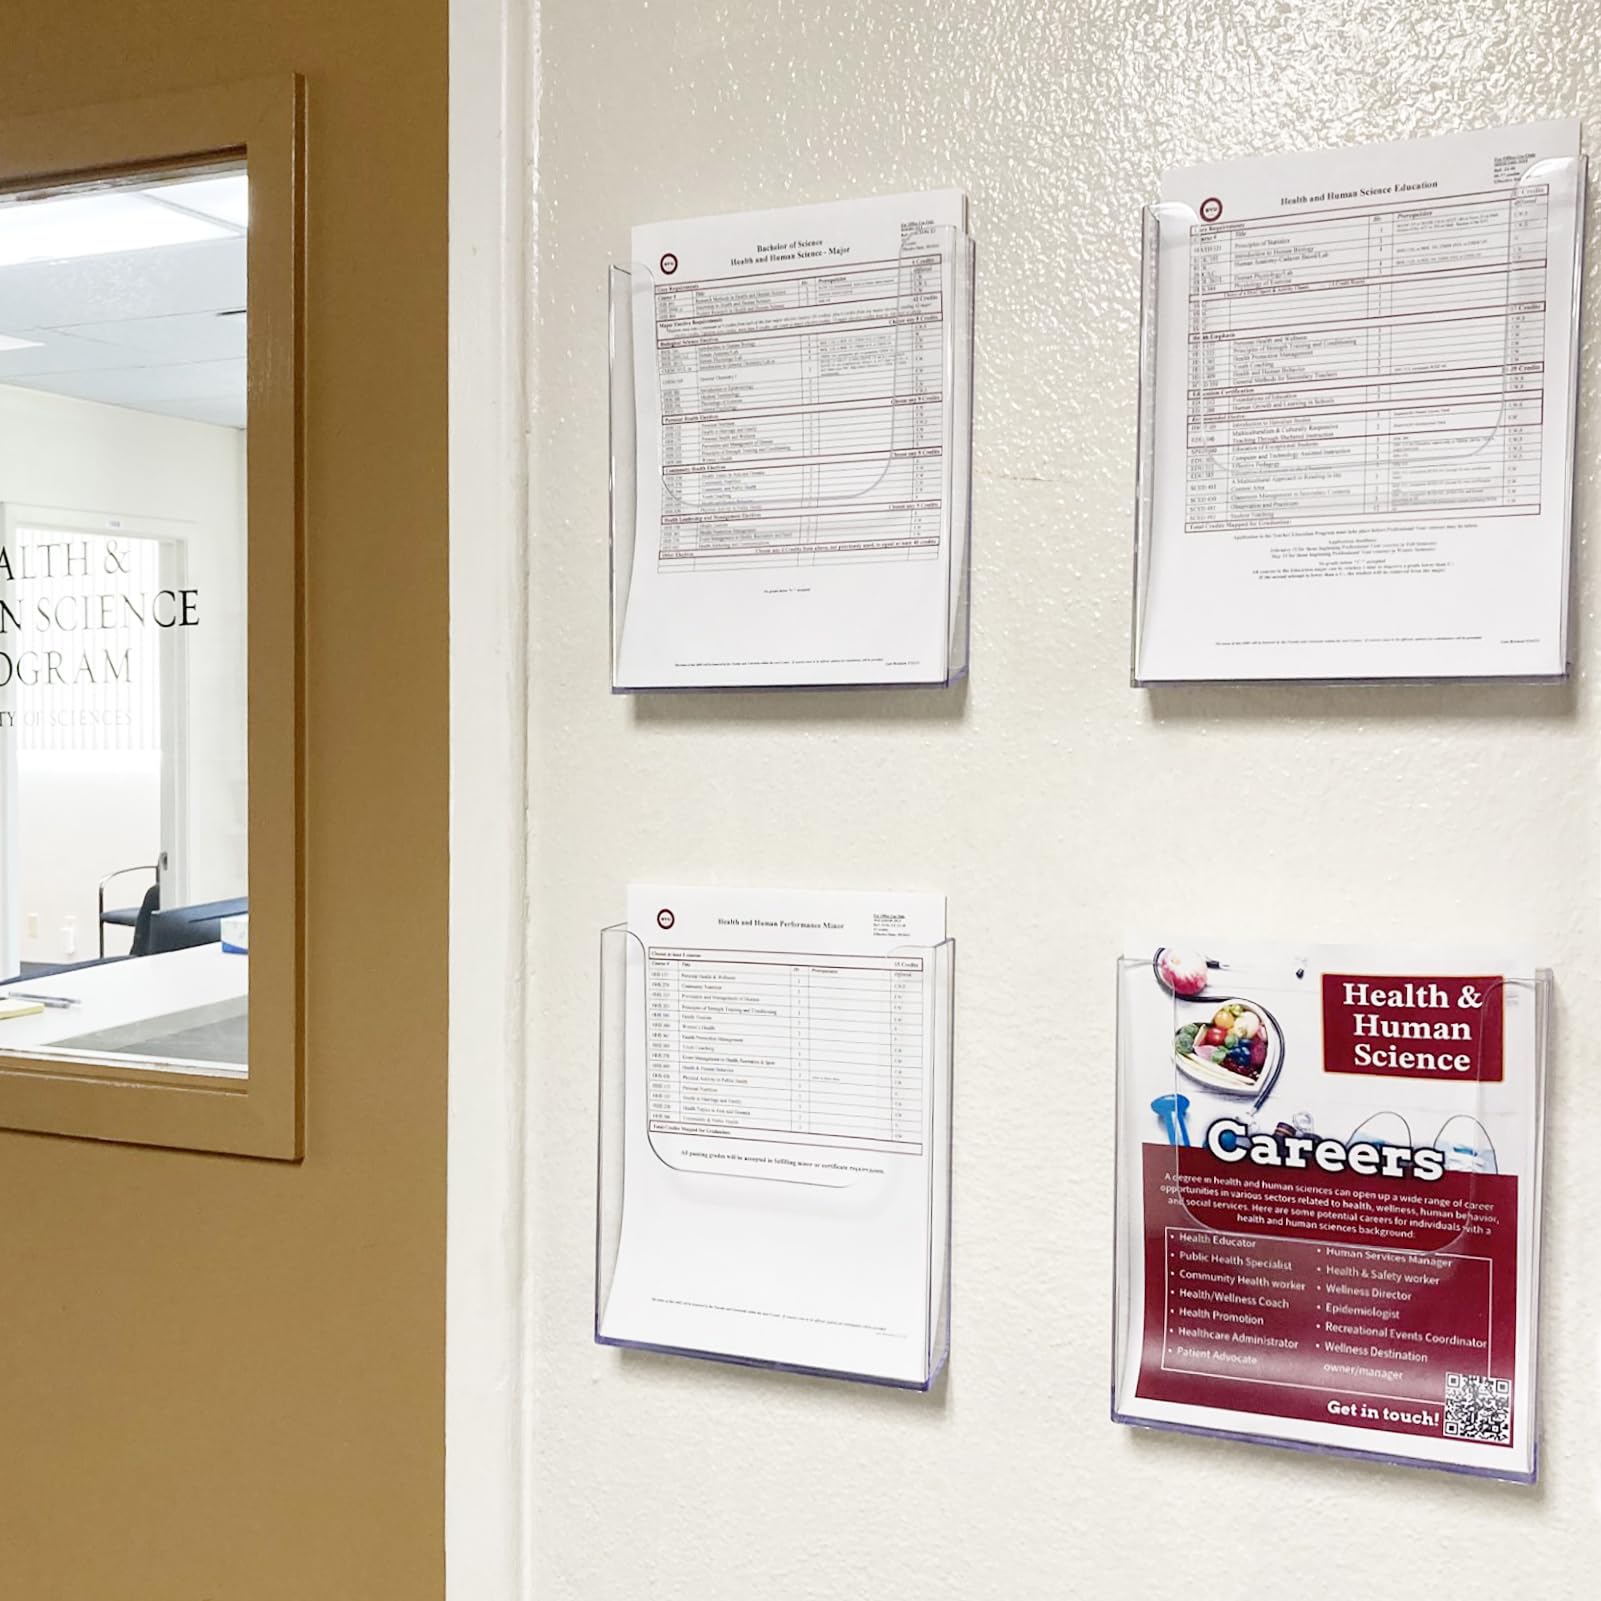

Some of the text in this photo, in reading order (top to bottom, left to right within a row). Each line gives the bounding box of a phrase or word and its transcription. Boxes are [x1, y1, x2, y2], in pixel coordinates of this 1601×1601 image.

[1281, 181, 1438, 206] Health and Human Science Education
[731, 256, 753, 266] Health
[755, 255, 768, 263] and
[770, 254, 795, 262] Human
[797, 250, 822, 258] Science
[828, 247, 850, 256] Major
[757, 244, 787, 253] Bachelor
[798, 239, 823, 248] Science
[104, 539, 131, 575] &
[36, 589, 200, 632] SCIENCE
[50, 711, 133, 727] SCIENCES
[718, 918, 739, 926] Health
[779, 920, 821, 929] Performance
[1342, 983, 1482, 1009] Health &
[1353, 1013, 1472, 1041] Human
[1354, 1044, 1471, 1072] Science
[1208, 1118, 1445, 1182] Careers
[822, 1162, 848, 1170] certificate
[1172, 1174, 1202, 1184] degree
[1214, 1176, 1242, 1187] health
[1243, 1179, 1260, 1188] and
[1261, 1180, 1294, 1192] human
[1295, 1184, 1333, 1196] sciences
[1335, 1188, 1351, 1197] can
[1352, 1190, 1376, 1200] open
[1378, 1193, 1390, 1201] up
[1400, 1194, 1423, 1204] wide
[1424, 1198, 1451, 1208] range
[1452, 1199, 1463, 1208] of
[1464, 1201, 1494, 1211] career
[1160, 1184, 1500, 1225] opportunities in various sectors related to health, wellness, human behavior,
[1168, 1197, 1185, 1205] and
[1186, 1198, 1211, 1207] social
[1213, 1201, 1248, 1211] services.
[1252, 1204, 1272, 1213] Here
[1274, 1207, 1289, 1215] are
[1291, 1208, 1315, 1217] some
[1317, 1209, 1358, 1221] potential
[1359, 1215, 1393, 1225] careers
[1394, 1217, 1407, 1226] for
[1409, 1219, 1461, 1232] individuals
[1462, 1224, 1484, 1234] with
[1237, 1213, 1415, 1239] health and human sciences background:
[1179, 1232, 1256, 1248] Health Educator
[1179, 1250, 1292, 1271] Public Health Specialist
[1326, 1247, 1453, 1269] Human Services Manager
[1179, 1269, 1306, 1291] Community Health worker
[1326, 1265, 1440, 1285] Health & Safety worker
[1179, 1288, 1290, 1309] Health/Wellness Coach
[1326, 1283, 1412, 1301] Wellness Director
[1179, 1307, 1264, 1326] Health Promotion
[1326, 1302, 1400, 1320] Epidemiologist
[1179, 1326, 1299, 1349] Healthcare Administrator
[1325, 1322, 1487, 1348] Recreational Events Coordinator
[1176, 1346, 1257, 1365] Patient Advocate
[1325, 1341, 1428, 1363] Wellness Destination
[1323, 1362, 1403, 1382] owner/manager
[1327, 1400, 1440, 1427] Get in touch!
